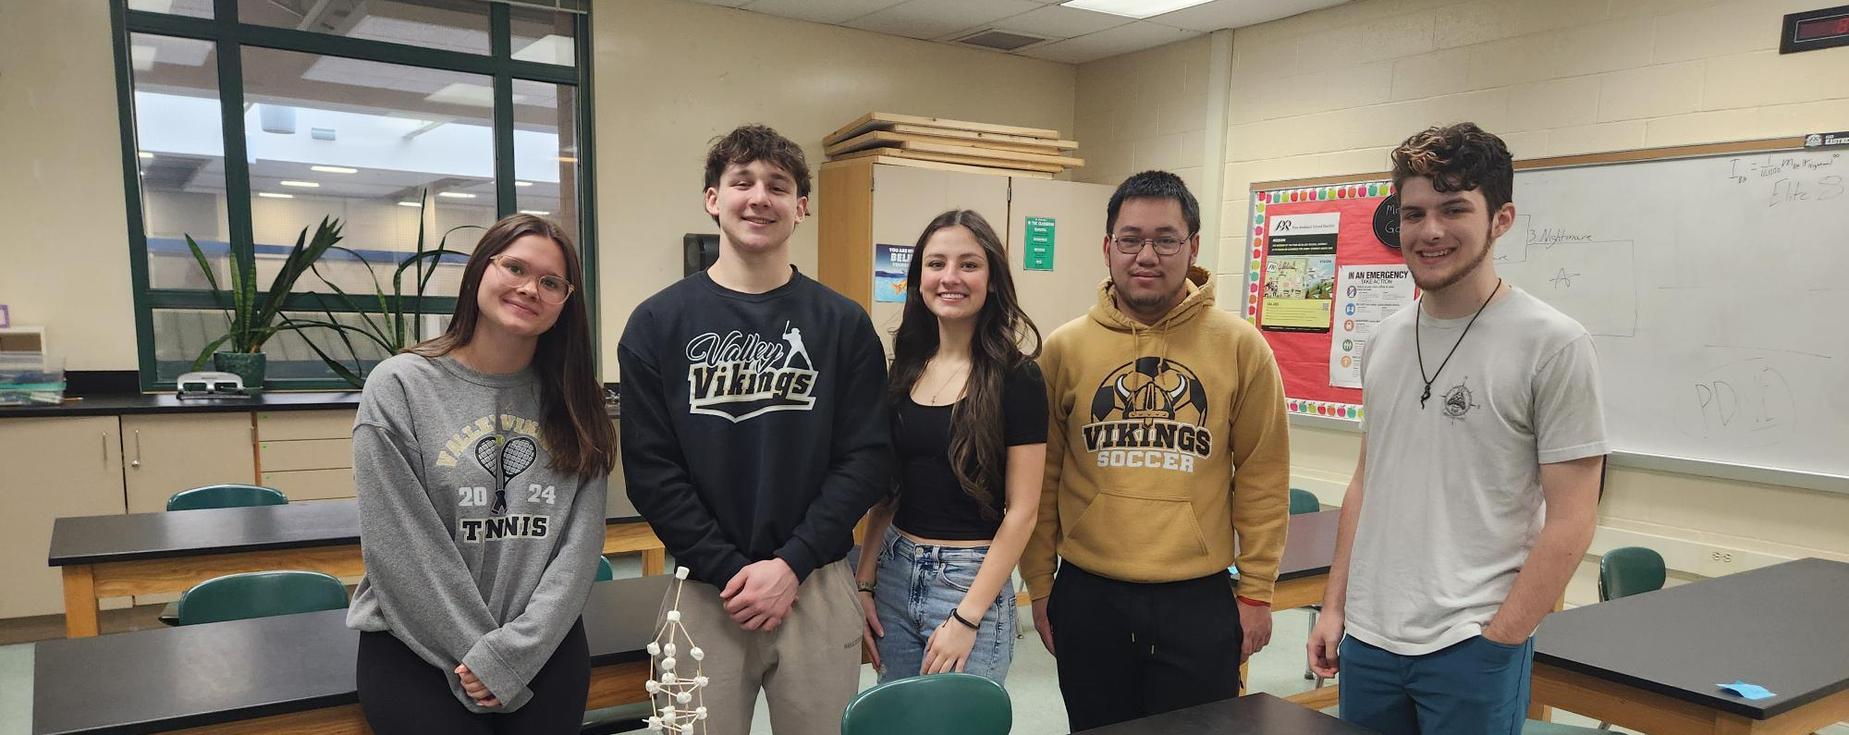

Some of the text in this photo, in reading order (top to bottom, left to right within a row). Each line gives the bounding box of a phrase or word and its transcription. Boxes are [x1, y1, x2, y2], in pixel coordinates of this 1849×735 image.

[1348, 270, 1409, 280] IN AN EMERGENCY
[686, 331, 784, 373] Valley
[692, 362, 813, 401] Vikings
[1083, 421, 1212, 459] VIKINGS
[1097, 450, 1194, 473] SOCCER
[458, 483, 557, 507] 20 24
[461, 515, 548, 541] TNNIS
